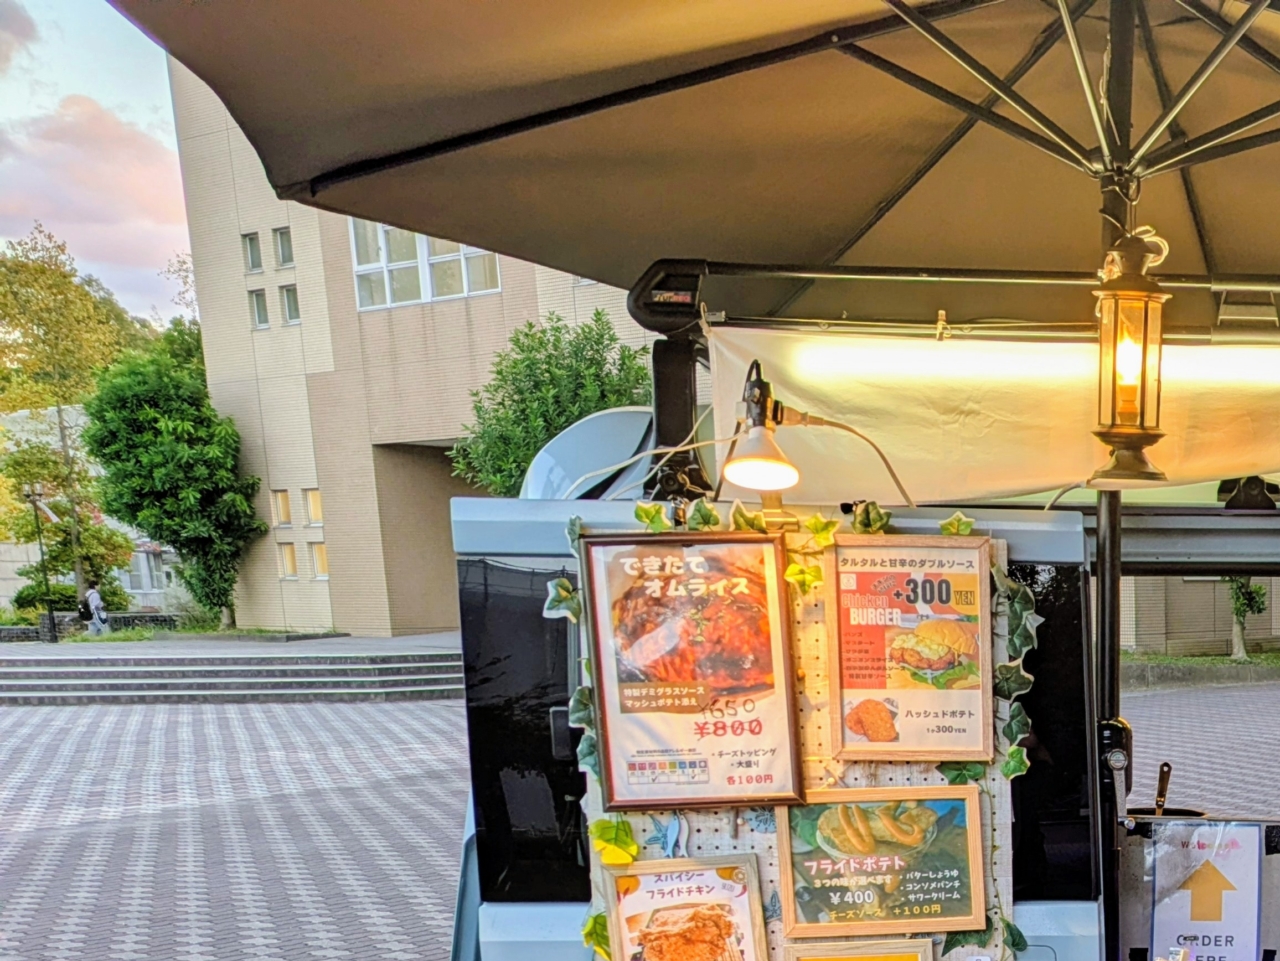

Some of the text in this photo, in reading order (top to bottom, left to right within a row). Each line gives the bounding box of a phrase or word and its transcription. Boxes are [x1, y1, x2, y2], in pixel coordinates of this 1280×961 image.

[619, 556, 706, 576] できたて
[840, 557, 975, 569] タルタルと甘辛のダブルソース
[643, 579, 750, 598] オムライス
[892, 578, 951, 605] +300
[953, 590, 976, 605] YEN
[841, 593, 889, 608] Chicken
[850, 608, 902, 625] BURGER
[623, 686, 705, 697] 特製デミグラスソース
[624, 697, 698, 708] マッシュポテト添え
[904, 709, 975, 719] ハッシュドポテト
[804, 856, 905, 876] フライドポテト
[654, 871, 705, 883] スパイシー
[646, 885, 716, 899] フライドチキン
[829, 909, 883, 920] チーズソース
